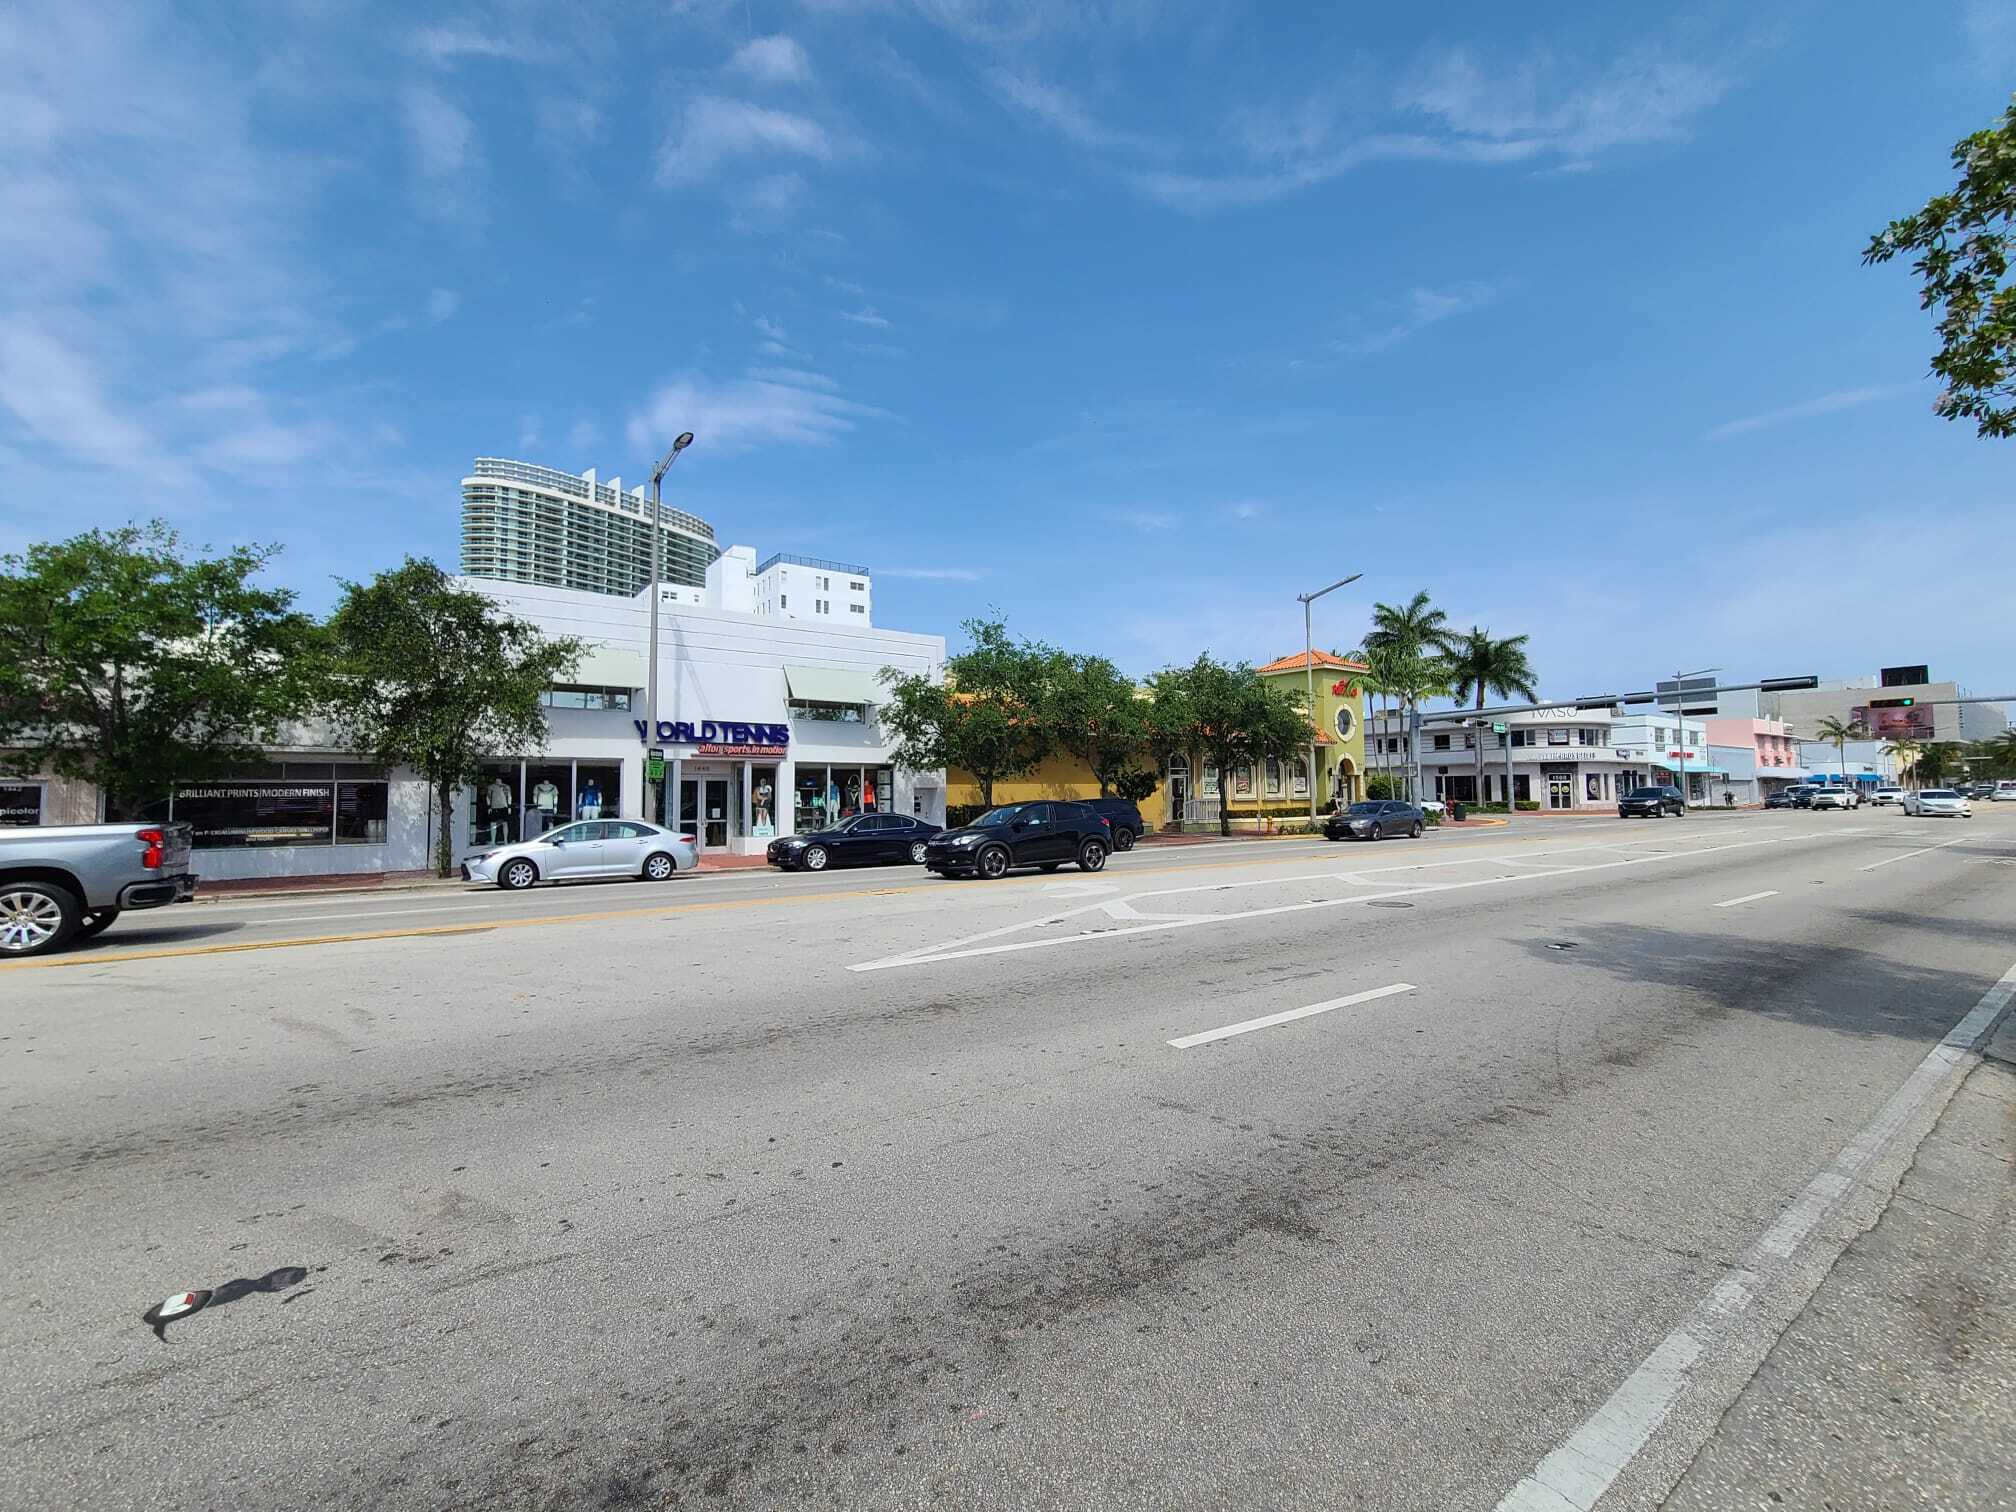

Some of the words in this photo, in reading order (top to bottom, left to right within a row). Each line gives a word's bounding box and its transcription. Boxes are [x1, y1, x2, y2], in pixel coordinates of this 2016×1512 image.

[634, 720, 717, 741] WORLD
[718, 722, 790, 744] TENNIS
[179, 788, 226, 798] BRILLIANT
[227, 788, 259, 798] PRINTS
[262, 788, 302, 797] MODERN
[303, 788, 330, 797] FINISH
